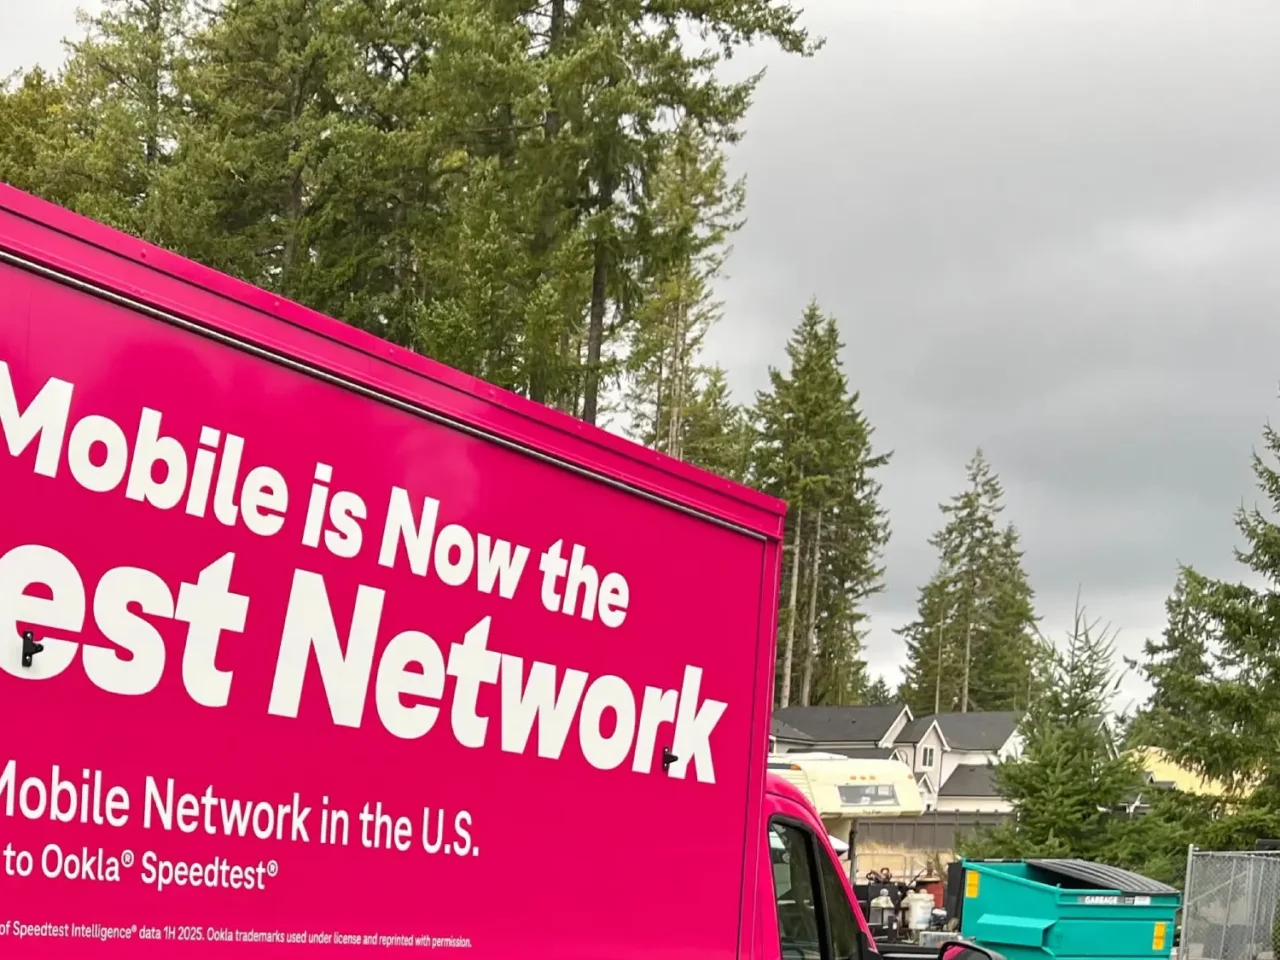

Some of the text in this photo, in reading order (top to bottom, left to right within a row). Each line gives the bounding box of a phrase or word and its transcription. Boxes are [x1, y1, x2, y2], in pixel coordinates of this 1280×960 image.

[301, 462, 368, 558] is
[377, 485, 531, 600] Now
[538, 538, 630, 628] the
[267, 568, 729, 784] Network
[143, 775, 312, 843] Network
[320, 795, 349, 846] in
[358, 801, 413, 852] the
[422, 806, 479, 857] U.S.
[2, 842, 34, 877] to
[12, 920, 69, 939] Speedtest
[139, 925, 161, 939] data
[163, 926, 175, 940] 1H
[177, 926, 204, 940] 2025.
[206, 927, 233, 941] Ookla
[235, 928, 284, 943] trademarks
[286, 930, 307, 943] used
[308, 931, 332, 944] under
[333, 931, 361, 945] license
[363, 932, 378, 945] and
[379, 933, 413, 948] reprinted
[415, 934, 431, 947] with
[432, 935, 472, 949] permission.
